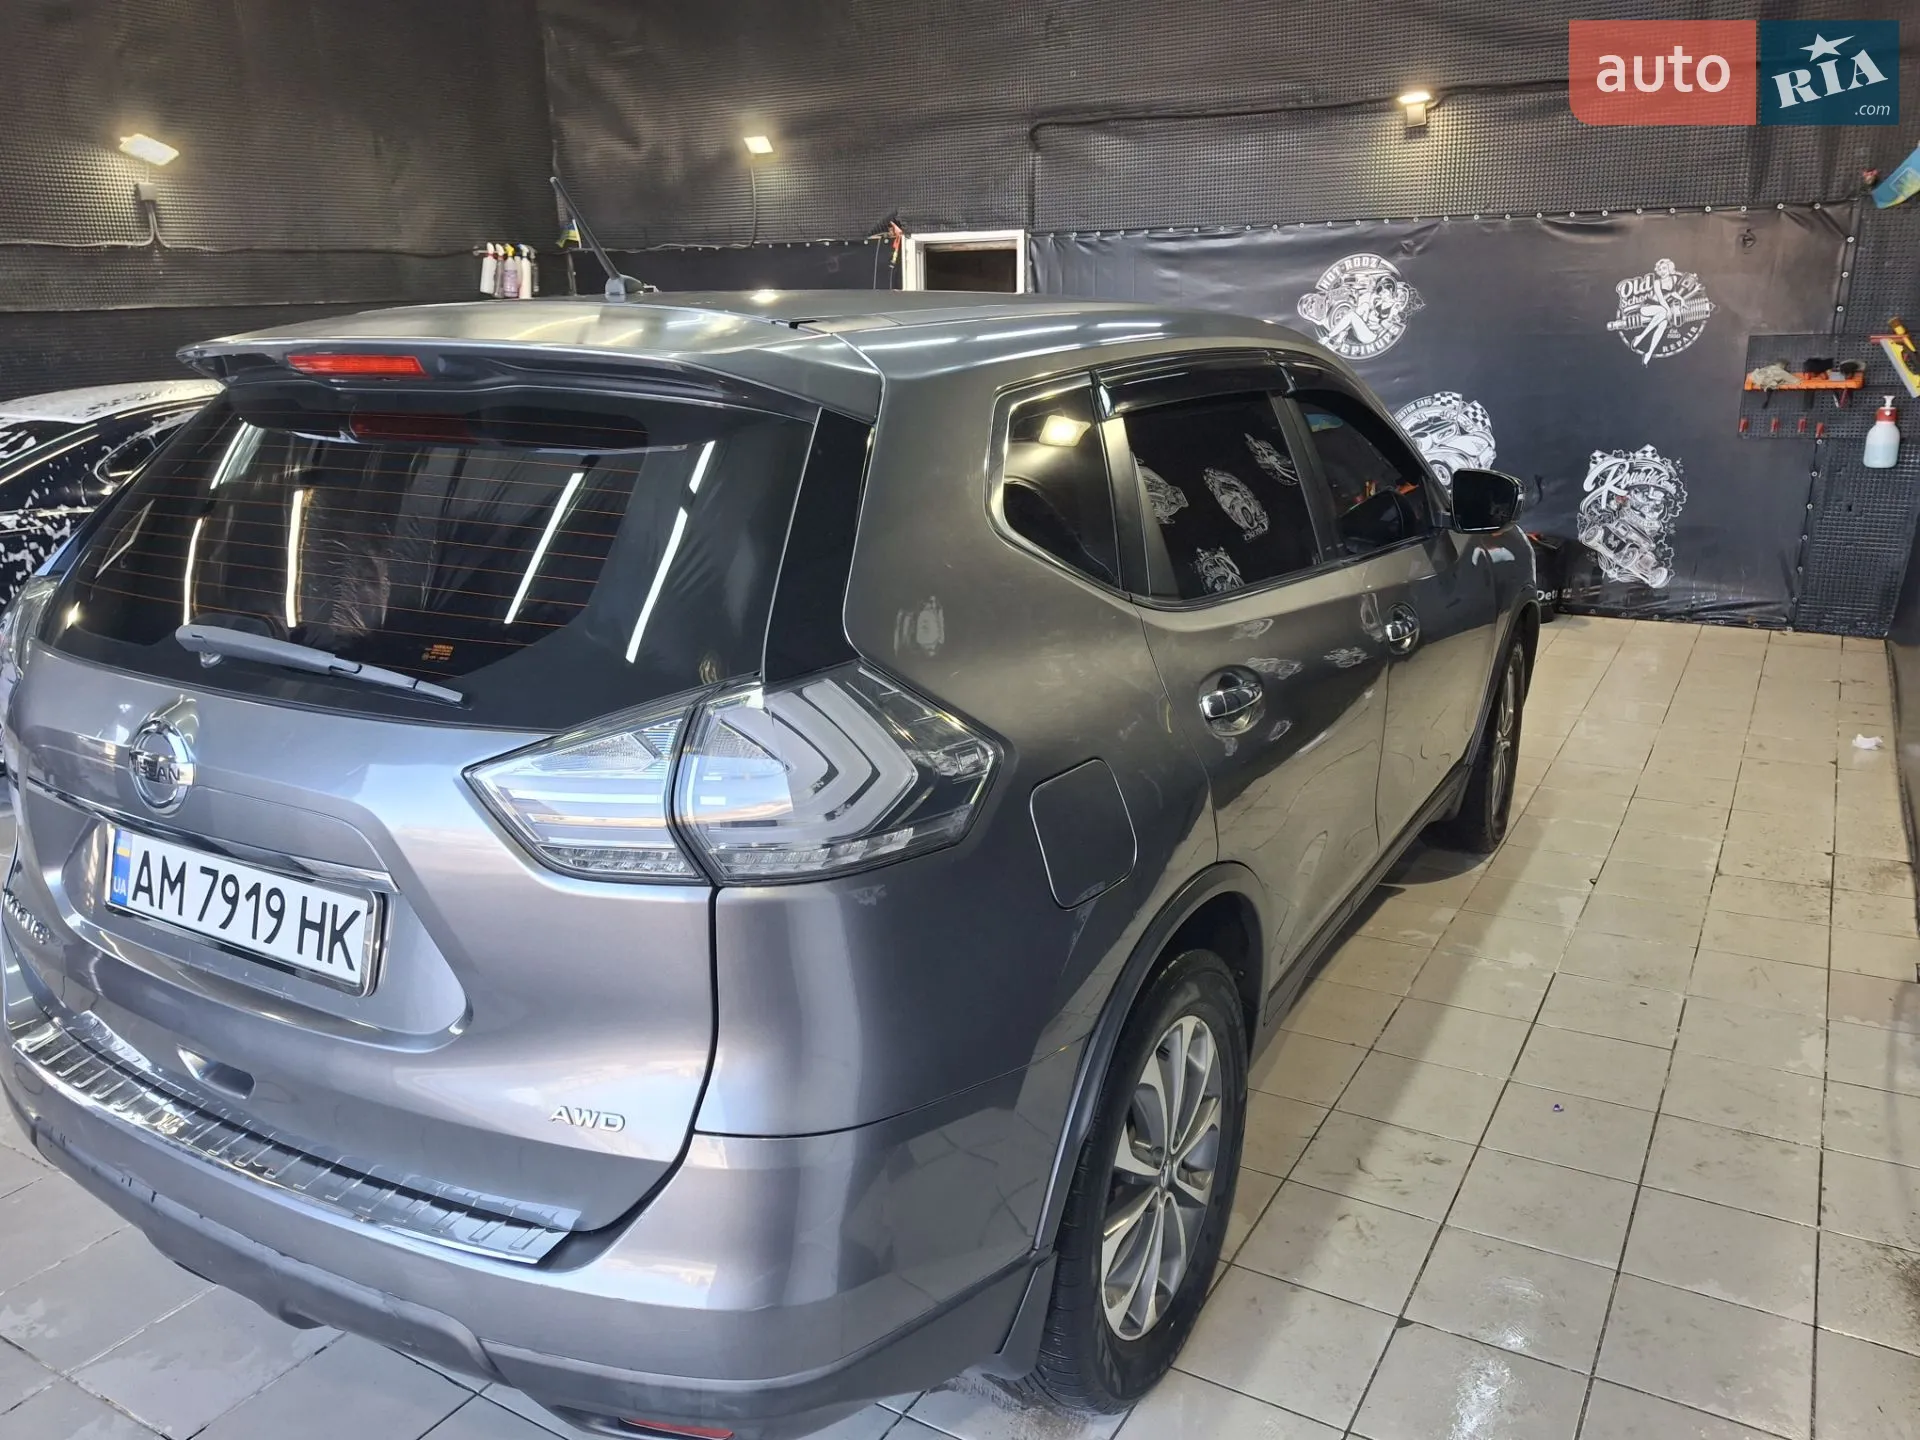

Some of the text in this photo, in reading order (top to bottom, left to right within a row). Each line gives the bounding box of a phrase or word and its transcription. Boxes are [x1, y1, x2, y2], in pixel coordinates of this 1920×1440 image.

[1320, 256, 1380, 290] HOT RODZ
[1618, 275, 1653, 298] Old
[1351, 325, 1400, 355] PINUPS
[1662, 326, 1699, 352] REPAIR
[113, 876, 127, 896] UA
[132, 850, 361, 971] AM 7919 HK
[548, 1105, 625, 1132] AWD
